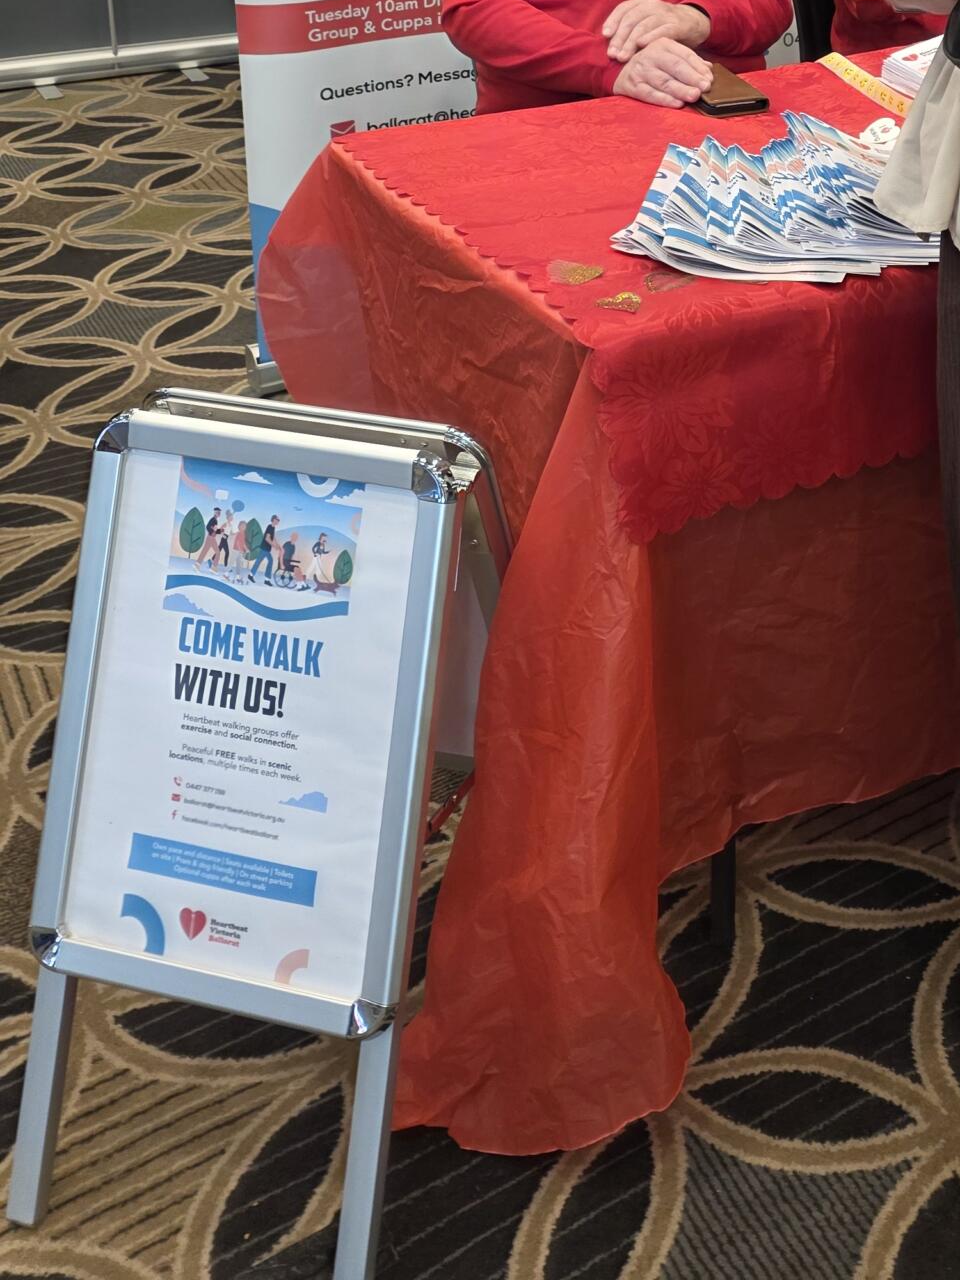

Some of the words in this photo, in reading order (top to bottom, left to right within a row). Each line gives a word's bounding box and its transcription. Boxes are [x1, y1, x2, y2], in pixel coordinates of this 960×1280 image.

[305, 4, 370, 24] Tuesday
[376, 0, 418, 14] 10am
[308, 25, 359, 42] Group
[363, 21, 376, 33] &
[381, 15, 433, 32] Cuppa
[320, 74, 414, 101] Questions?
[418, 69, 478, 85] Messag
[178, 616, 247, 662] COME
[252, 629, 324, 678] WALK
[173, 663, 240, 711] WITH
[243, 675, 287, 718] US!
[181, 723, 212, 734] exercise
[214, 729, 228, 737] and
[230, 731, 252, 741] social
[254, 736, 298, 750] connection.
[183, 713, 220, 727] Heartbeat
[222, 720, 250, 733] walking
[252, 726, 279, 738] groups
[280, 730, 299, 740] offer
[182, 743, 214, 755] Peaceful
[215, 749, 236, 760] FREE
[237, 754, 258, 765] walks
[259, 757, 267, 766] in
[268, 760, 292, 771] scenic
[207, 759, 237, 771] multiple
[238, 764, 259, 775] times
[260, 768, 278, 778] each
[280, 773, 302, 782] week.
[210, 919, 248, 933] Heartbeat
